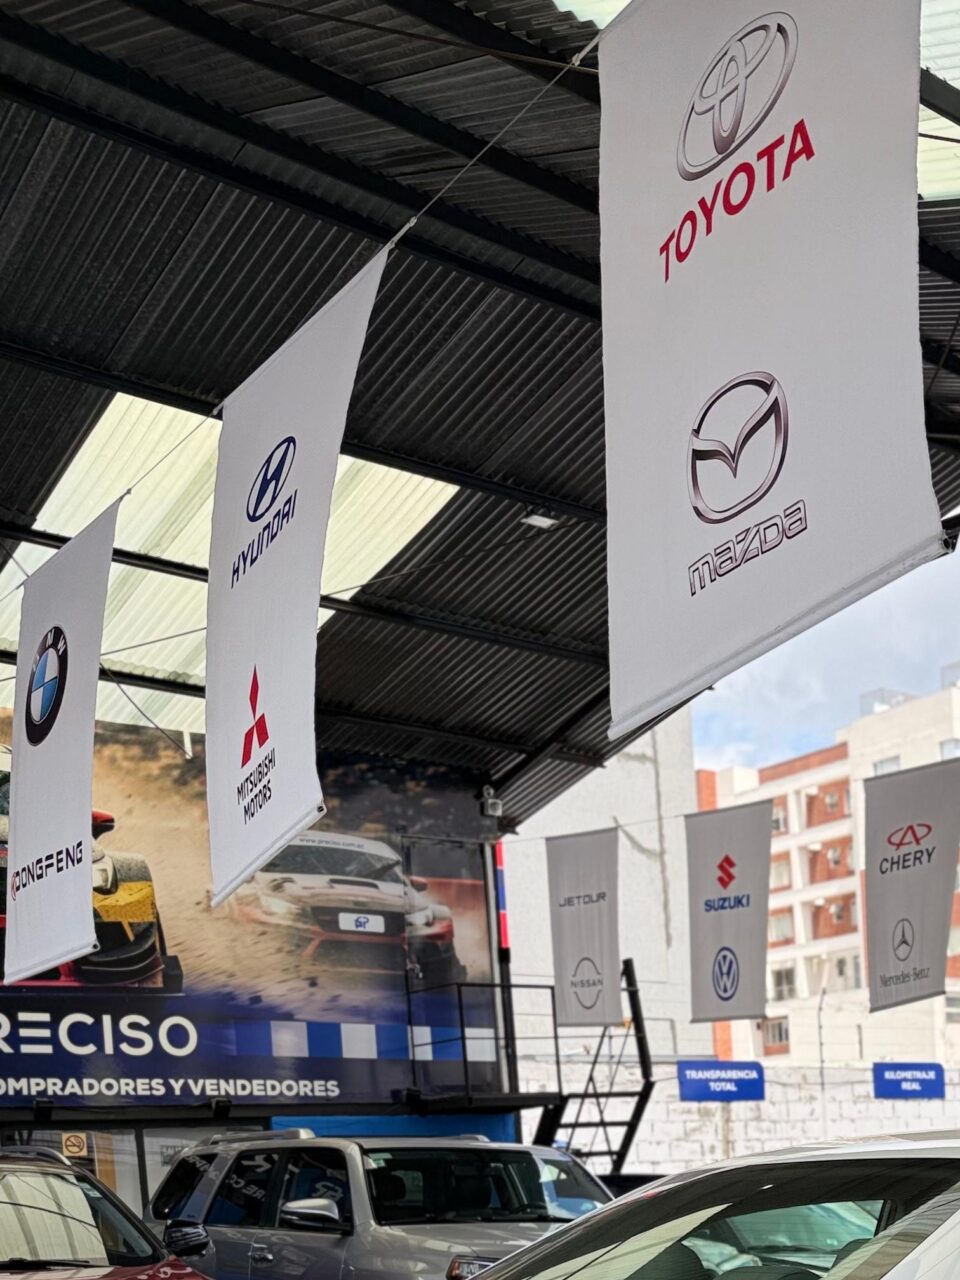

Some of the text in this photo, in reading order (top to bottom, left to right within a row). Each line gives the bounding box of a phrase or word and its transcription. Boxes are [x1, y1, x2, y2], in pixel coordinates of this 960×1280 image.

[658, 117, 815, 283] TOYOTA
[231, 489, 298, 589] HYUNDAI
[689, 499, 807, 596] mazda
[237, 747, 275, 806] MITSUBISHI
[243, 778, 272, 825] MOTORS
[15, 840, 83, 892] DONGFENG
[879, 846, 936, 875] CHERY
[558, 891, 607, 907] JETOUR
[704, 894, 750, 912] SUZUKI
[570, 979, 603, 989] NISSAN
[685, 1069, 758, 1081] TRANSPARENCIA
[884, 1070, 935, 1081] KILOMETRAJE
[169, 1079, 185, 1096] Y
[188, 1079, 340, 1098] VENDEDORES
[709, 1081, 737, 1091] TOTAL
[901, 1081, 921, 1091] REAL
